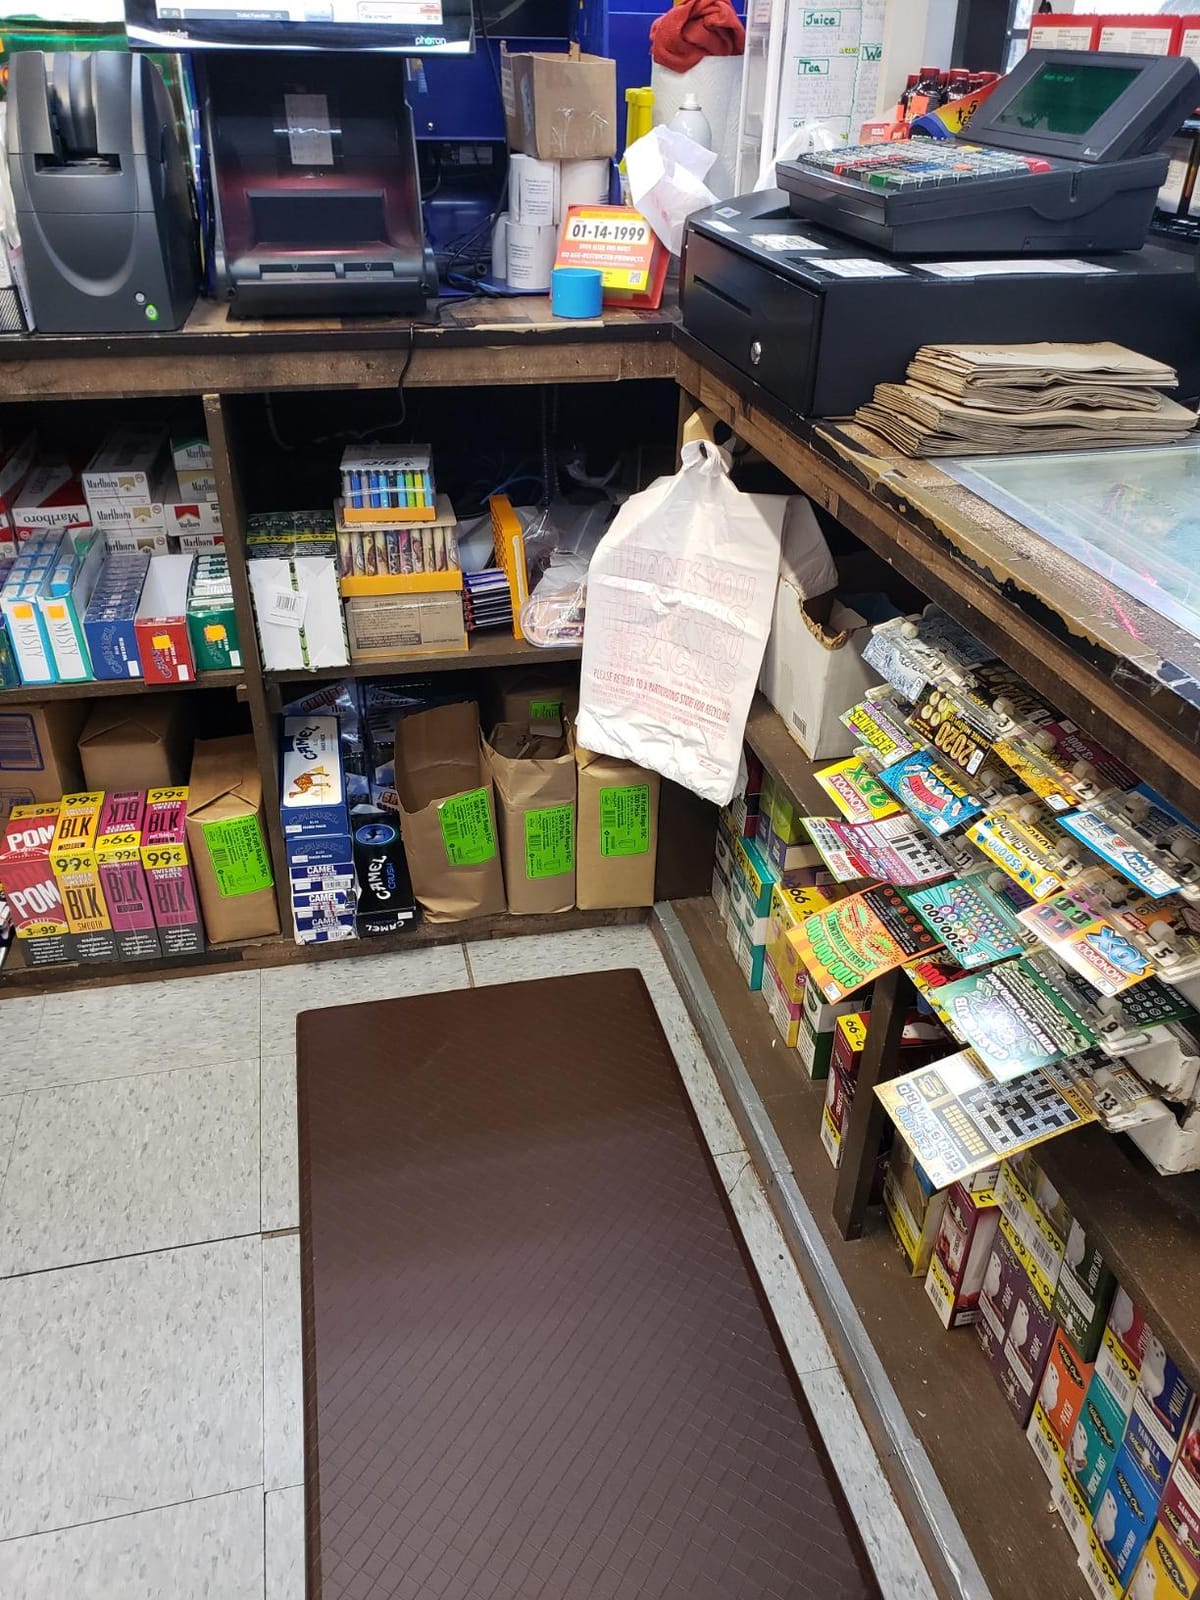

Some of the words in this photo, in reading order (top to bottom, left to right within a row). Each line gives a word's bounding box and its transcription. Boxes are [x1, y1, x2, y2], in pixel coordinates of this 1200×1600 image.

[806, 14, 835, 25] Juice
[802, 62, 820, 72] Tea
[572, 224, 645, 241] 01-14-1999
[87, 478, 118, 490] Marlboro
[23, 512, 80, 523] Marlboro
[97, 510, 131, 520] Marlboro
[183, 538, 213, 548] Marlboro
[18, 624, 45, 659] MISTY
[55, 622, 79, 657] MISTY
[296, 725, 320, 760] CAMEL
[933, 719, 978, 767] 2020
[152, 791, 184, 800] 99¢
[828, 774, 869, 814] MONOPOLY
[843, 762, 891, 808] 25X
[1077, 783, 1092, 794] 2
[65, 796, 98, 805] 99¢
[110, 801, 138, 823] BLK
[148, 812, 179, 834] BLK
[7, 825, 55, 852] POM
[61, 816, 91, 839] BLK
[56, 857, 91, 873] 99¢
[115, 851, 137, 860] 99¢
[147, 851, 182, 866] 99¢
[986, 838, 1024, 873] $50,000
[306, 865, 336, 874] CAMEL
[368, 856, 391, 900] CAMEL
[107, 872, 142, 904] BLK
[155, 882, 190, 913] BLK
[308, 893, 338, 902] CAMEL
[8, 880, 61, 919] POM
[66, 888, 103, 920] BLK
[26, 928, 33, 936] 3
[77, 921, 104, 930] SMOOTH
[312, 917, 340, 926] CAMEL
[365, 920, 404, 932] CAMEL
[921, 902, 969, 954] $200,000
[826, 917, 852, 953] EXTREME!
[803, 913, 864, 989] $100,000,000
[845, 948, 867, 970] CASH
[1084, 923, 1149, 977] 10X
[1072, 940, 1126, 985] MONOPOLY
[986, 972, 1021, 1011] $250,000!
[1016, 1008, 1031, 1023] TO
[1026, 1020, 1041, 1035] UP
[1036, 1031, 1057, 1054] WIN
[1100, 1092, 1118, 1112] 13
